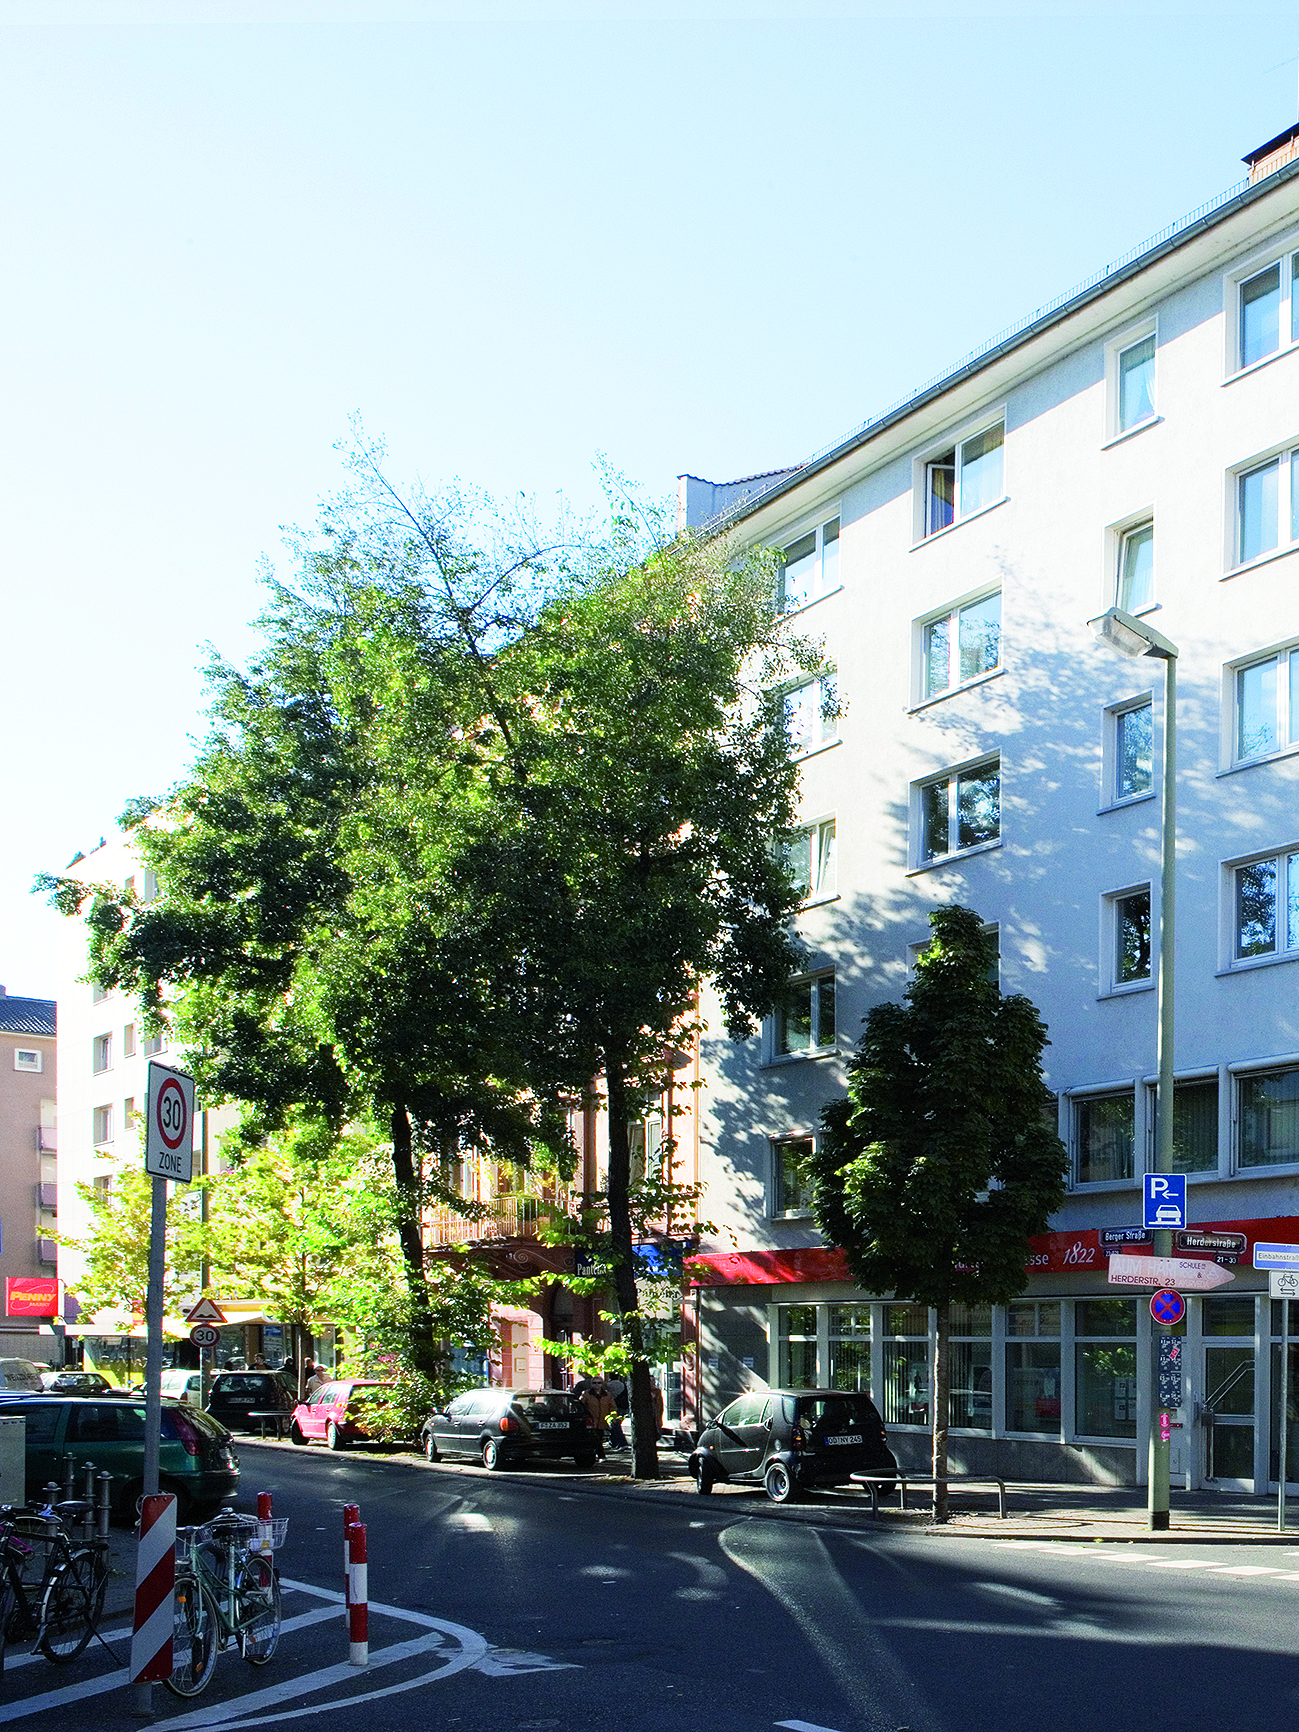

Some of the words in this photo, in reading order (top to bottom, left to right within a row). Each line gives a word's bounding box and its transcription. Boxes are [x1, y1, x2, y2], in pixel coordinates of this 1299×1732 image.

[163, 1095, 181, 1131] 30
[158, 1151, 182, 1173] ZONE
[1151, 1177, 1169, 1199] P
[1105, 1232, 1124, 1242] Berger
[1126, 1230, 1146, 1240] Straße
[1186, 1236, 1236, 1249] Herderstraße
[1062, 1241, 1096, 1265] 1822
[1111, 1274, 1162, 1286] HERDERSTR.
[1164, 1278, 1176, 1287] 23
[9, 1290, 57, 1302] PENNY
[196, 1330, 214, 1342] 30
